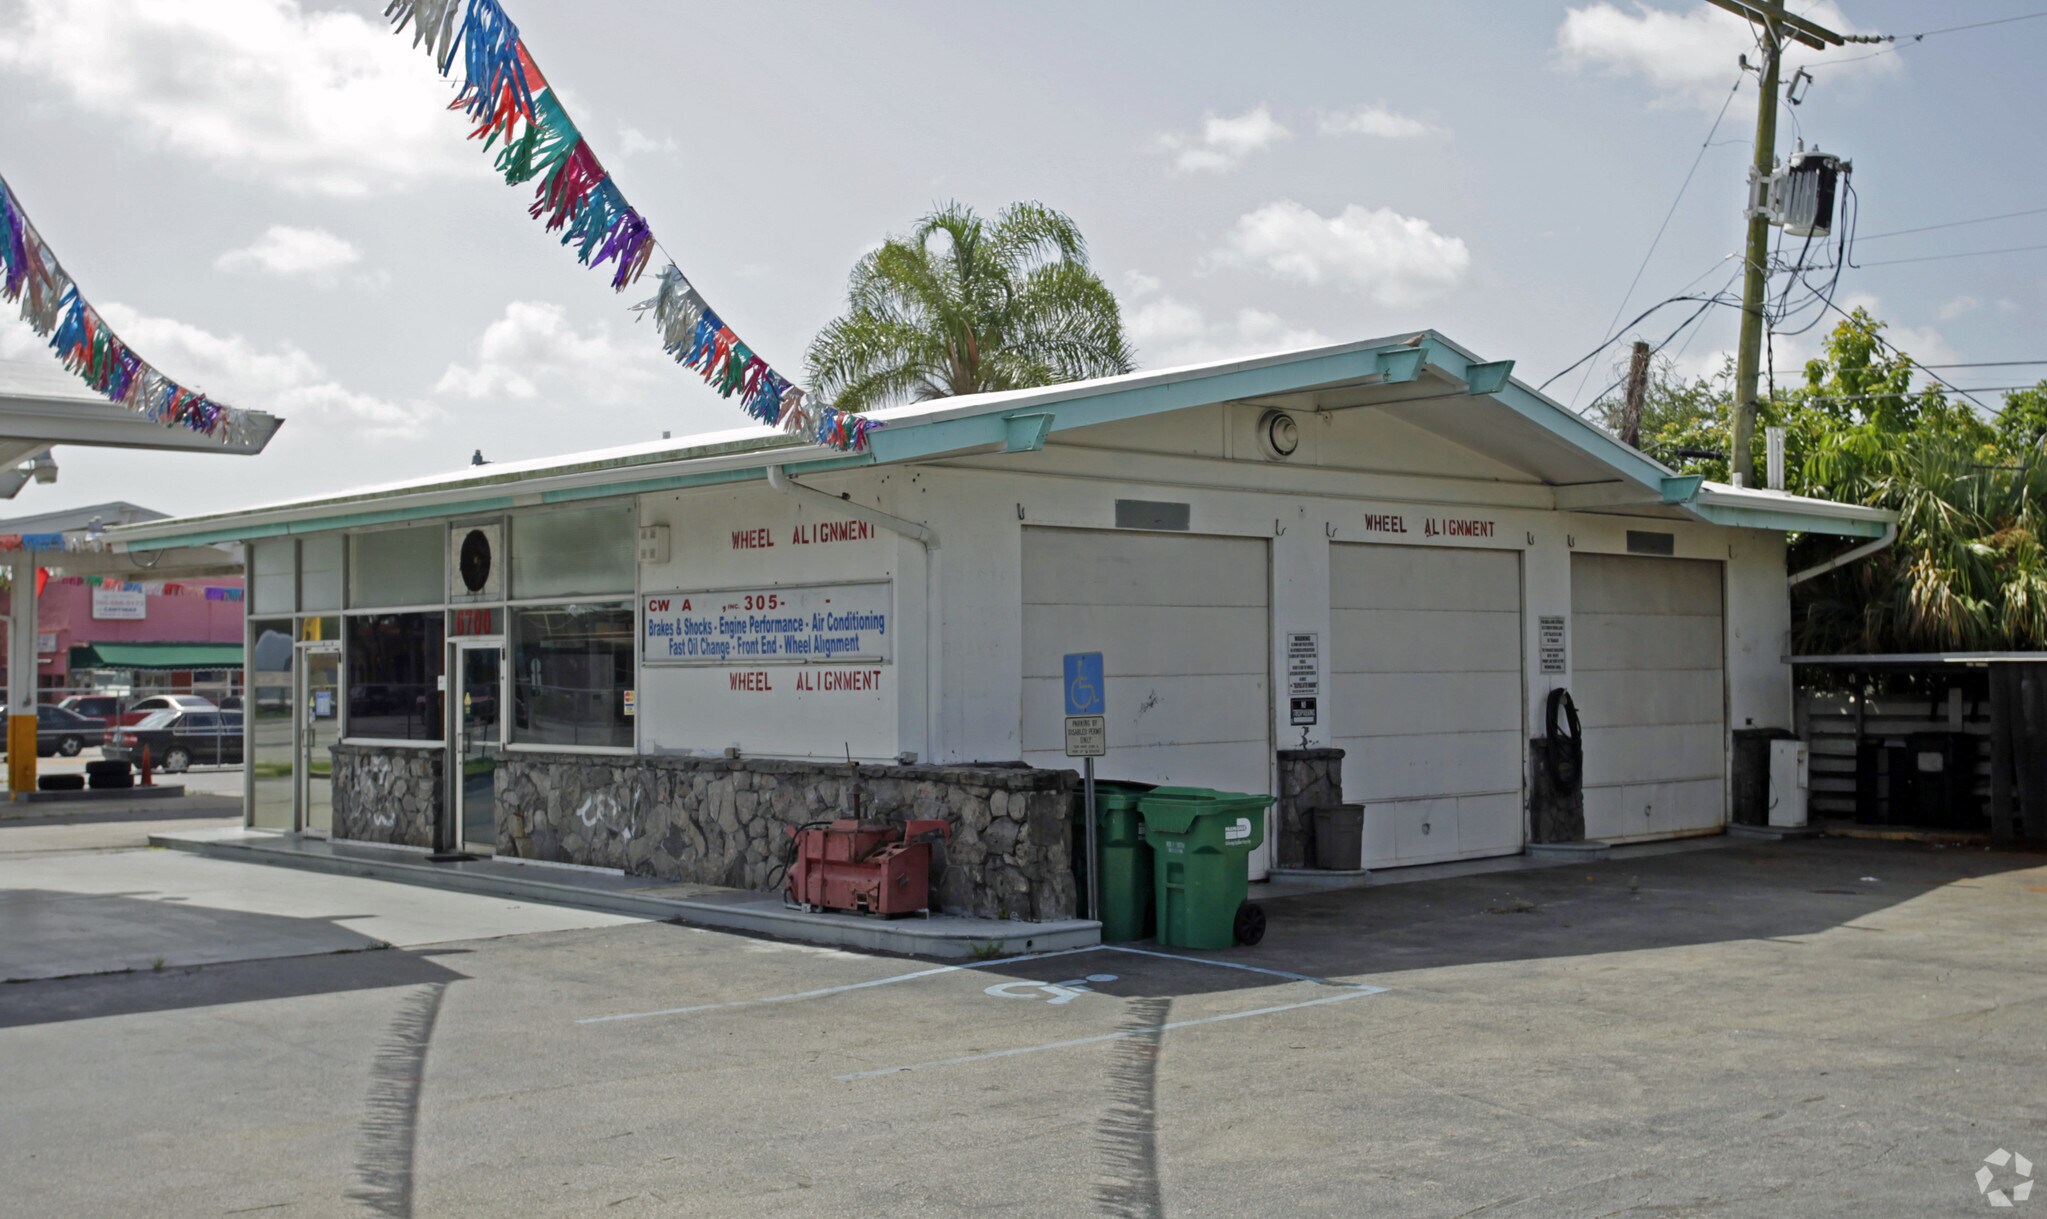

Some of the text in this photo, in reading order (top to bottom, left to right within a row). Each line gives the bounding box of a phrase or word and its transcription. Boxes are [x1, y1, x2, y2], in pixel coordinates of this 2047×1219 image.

[1365, 514, 1495, 538] WHEEL ALIGNMENT
[731, 527, 774, 550] WHEEL
[648, 599, 670, 612] CW
[456, 608, 491, 636] 6700
[648, 619, 674, 636] Brakes
[676, 618, 682, 635] &
[684, 617, 712, 635] Shocks
[719, 616, 747, 639] Engine
[749, 614, 803, 634] Performance
[812, 612, 825, 632] Air
[827, 610, 885, 635] Conditioning
[669, 637, 685, 655] Fast
[687, 636, 698, 655] Oil
[700, 636, 730, 660] Change
[737, 635, 759, 655] Front
[761, 635, 777, 654] End
[784, 634, 811, 653] Wheel
[813, 633, 859, 658] Alignment
[729, 670, 881, 691] WHEEL ALIGNMENT
[1068, 727, 1102, 736] DISABLED PERMIT
[1072, 719, 1091, 727] PARKING
[1080, 736, 1091, 744] ONLY
